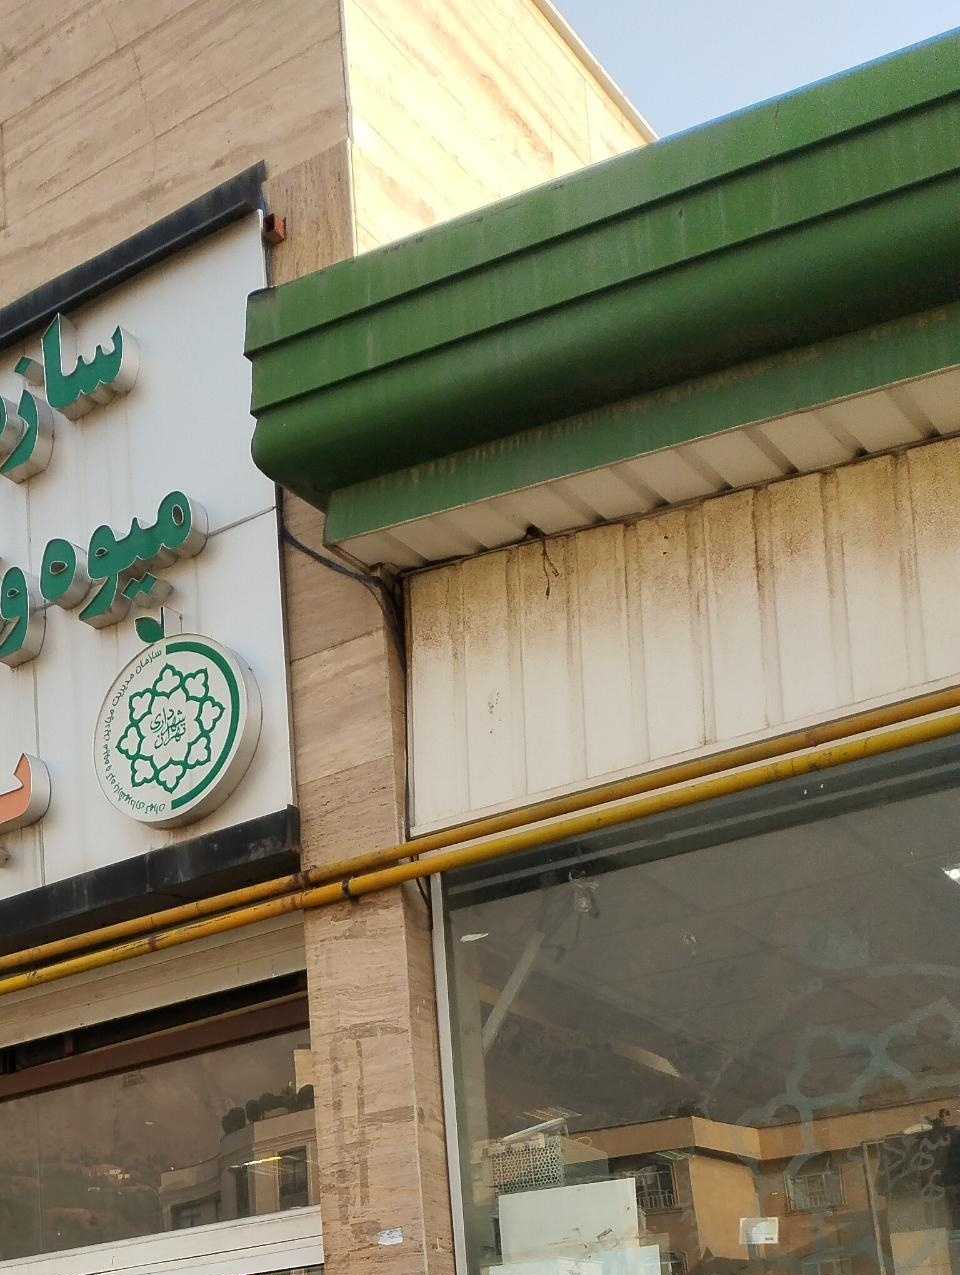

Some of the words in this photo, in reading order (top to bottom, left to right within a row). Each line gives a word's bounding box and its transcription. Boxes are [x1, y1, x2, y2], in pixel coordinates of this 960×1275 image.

[40, 491, 191, 621] میوه
[135, 650, 162, 674] سازمان
[112, 673, 135, 706] مدیریت
[103, 709, 115, 741] میادین
[144, 803, 166, 814] تهران
